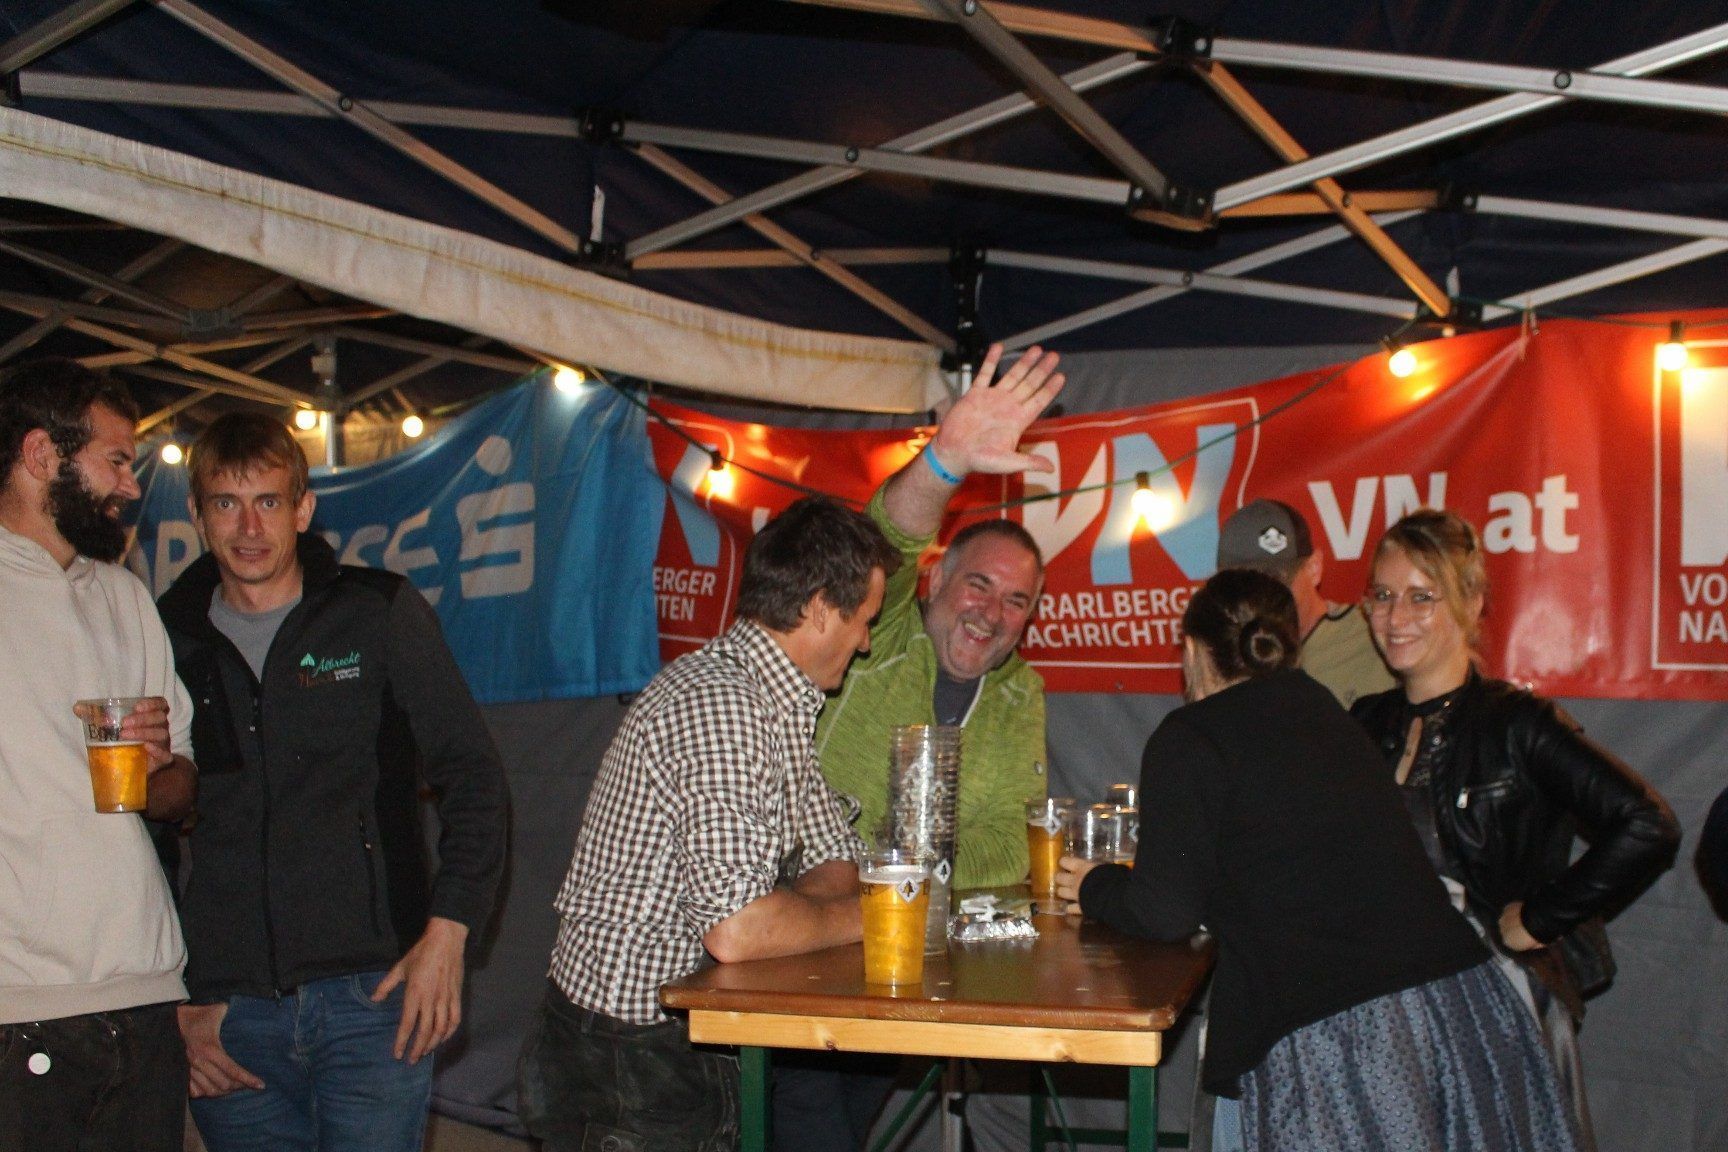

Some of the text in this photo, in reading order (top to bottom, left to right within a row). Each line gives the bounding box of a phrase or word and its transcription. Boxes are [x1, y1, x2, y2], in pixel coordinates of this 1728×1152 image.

[652, 565, 717, 597] ERGER
[1679, 572, 1728, 606] VO
[655, 593, 696, 622] TEN
[1038, 584, 1200, 621] RARLBERG
[1022, 617, 1185, 649] ACHRICHTE
[1679, 610, 1728, 644] NA
